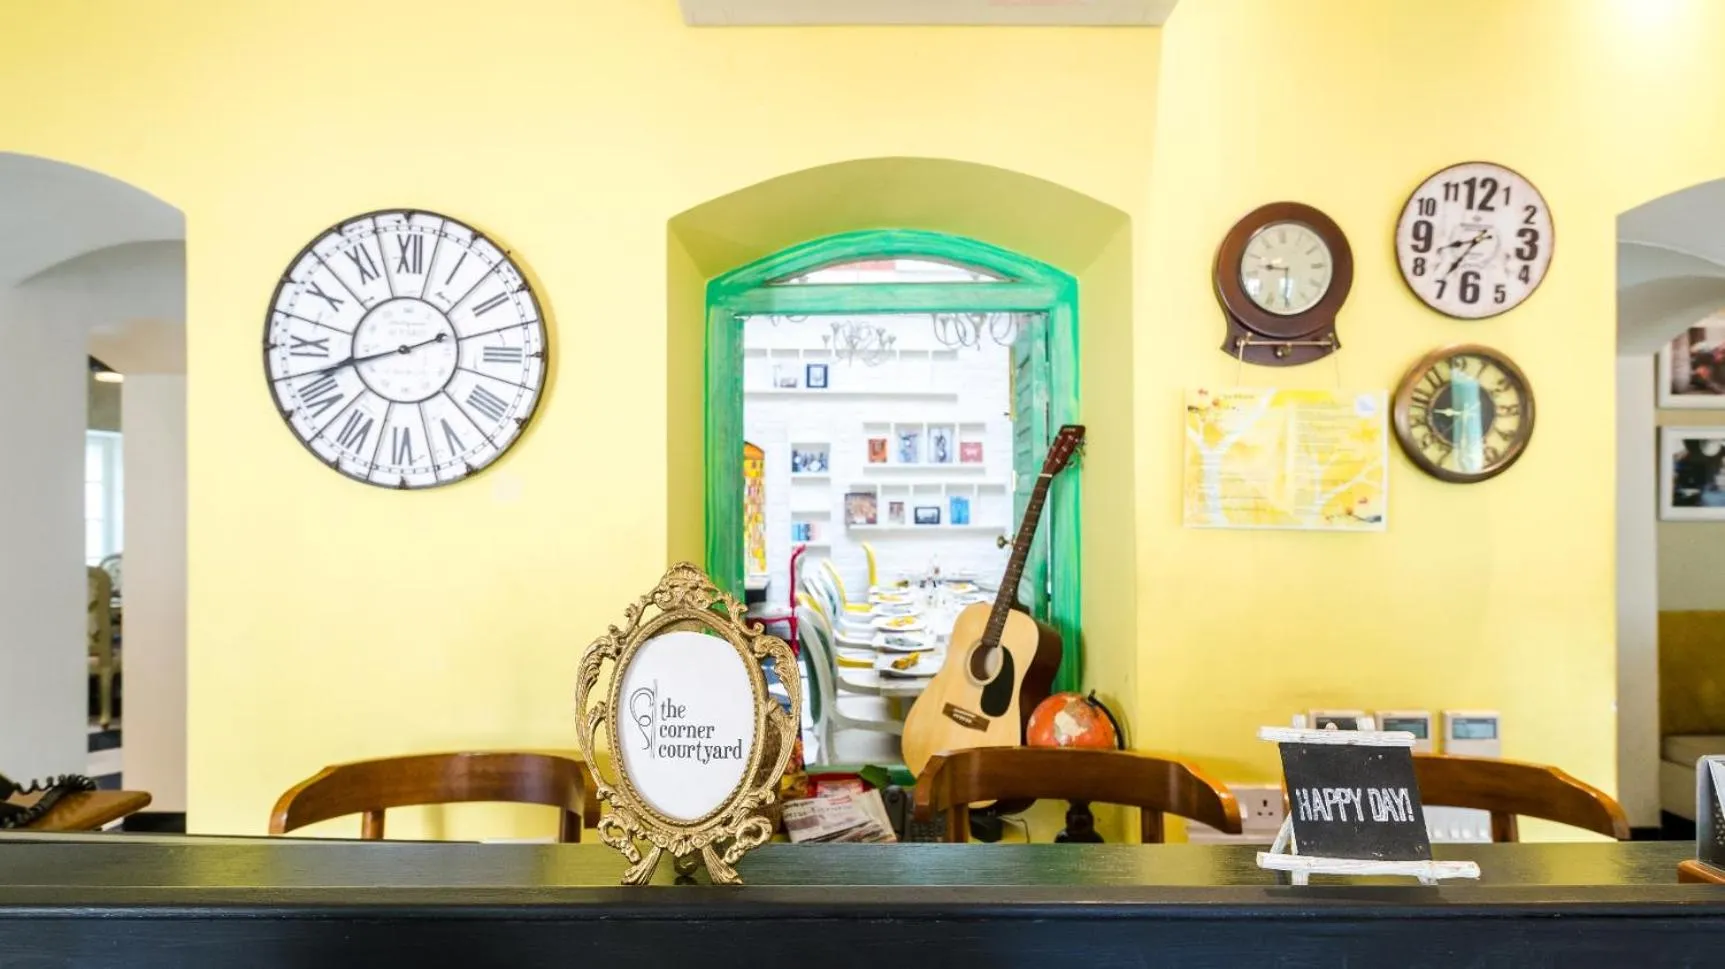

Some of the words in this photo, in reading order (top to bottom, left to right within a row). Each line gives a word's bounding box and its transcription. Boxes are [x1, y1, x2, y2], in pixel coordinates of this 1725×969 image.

[1443, 182, 1459, 202] 11
[1463, 177, 1499, 212] 12
[1503, 186, 1511, 206] 1
[1418, 198, 1436, 217] 10
[1524, 205, 1538, 225] 2
[1411, 220, 1433, 253] 9
[1515, 228, 1539, 261] 3
[344, 243, 380, 285] XI
[397, 234, 423, 274] XII
[1412, 257, 1426, 276] 8
[445, 252, 467, 285] I
[1518, 264, 1530, 284] 4
[306, 281, 344, 312] X
[1434, 280, 1447, 299] 7
[1458, 270, 1481, 304] 6
[1494, 284, 1506, 304] 5
[472, 291, 509, 317] II
[289, 335, 330, 357] IX
[483, 346, 522, 363] III
[466, 385, 509, 422] IIII
[336, 409, 374, 454] VII
[440, 418, 466, 456] V
[392, 426, 413, 466] VI
[660, 697, 686, 721] the
[659, 724, 715, 739] corner
[658, 738, 743, 765] courtyard
[1296, 787, 1365, 822] HAPPY
[1367, 787, 1415, 822] DAY!
